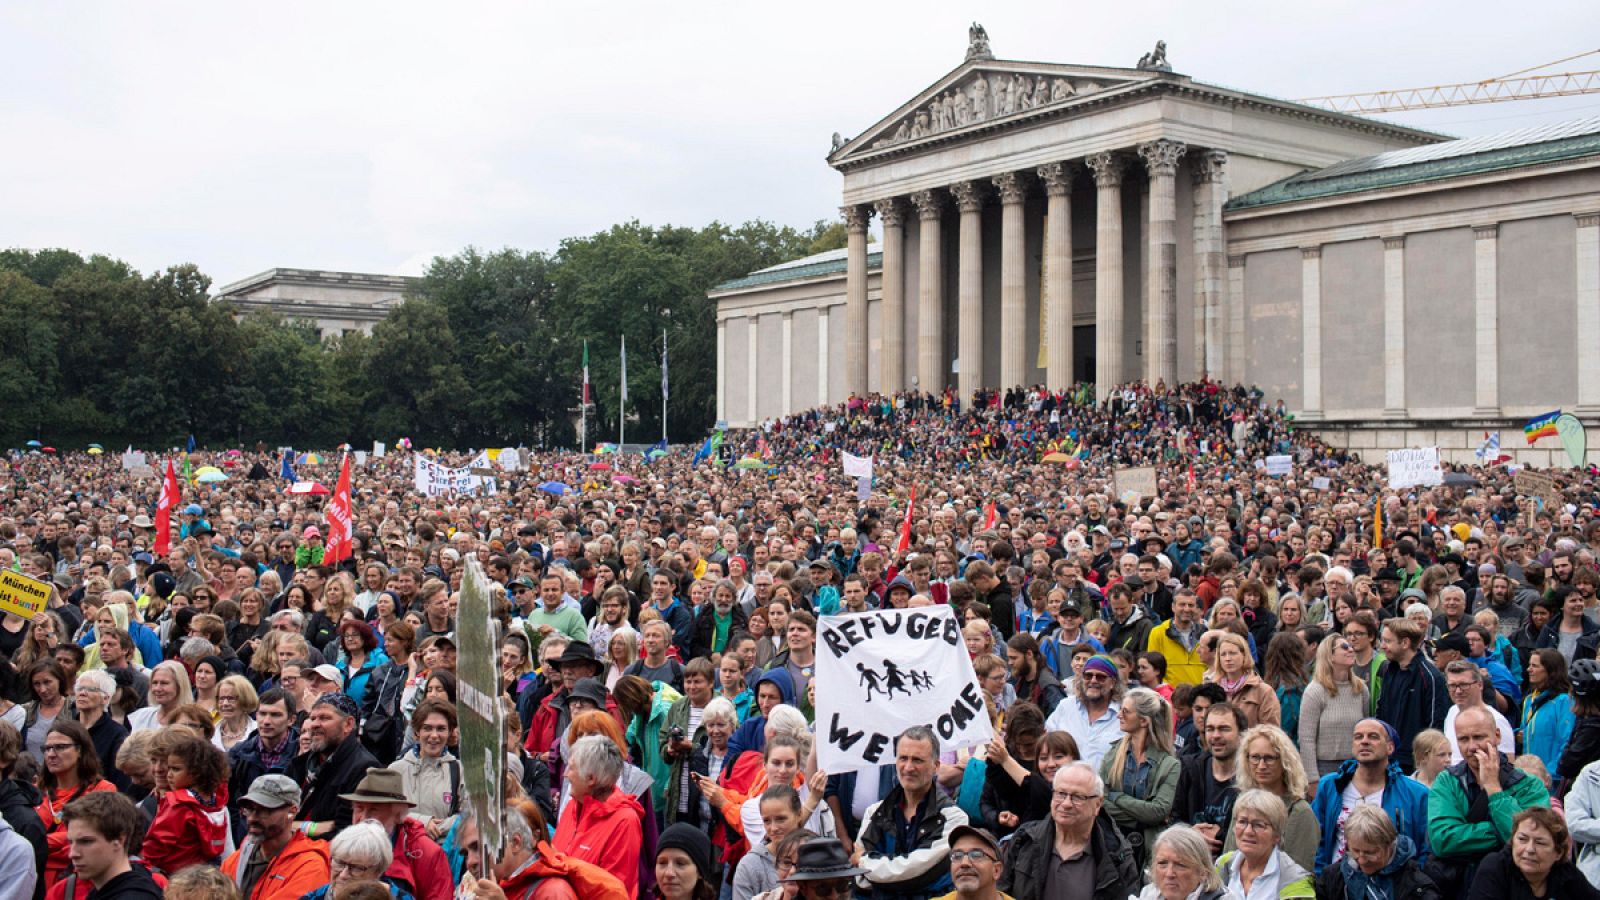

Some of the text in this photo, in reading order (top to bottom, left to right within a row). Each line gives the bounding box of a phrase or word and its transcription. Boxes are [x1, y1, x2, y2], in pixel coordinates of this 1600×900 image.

[3, 576, 45, 598] München
[0, 590, 39, 612] ist bunt!
[829, 682, 983, 764] WEOME
